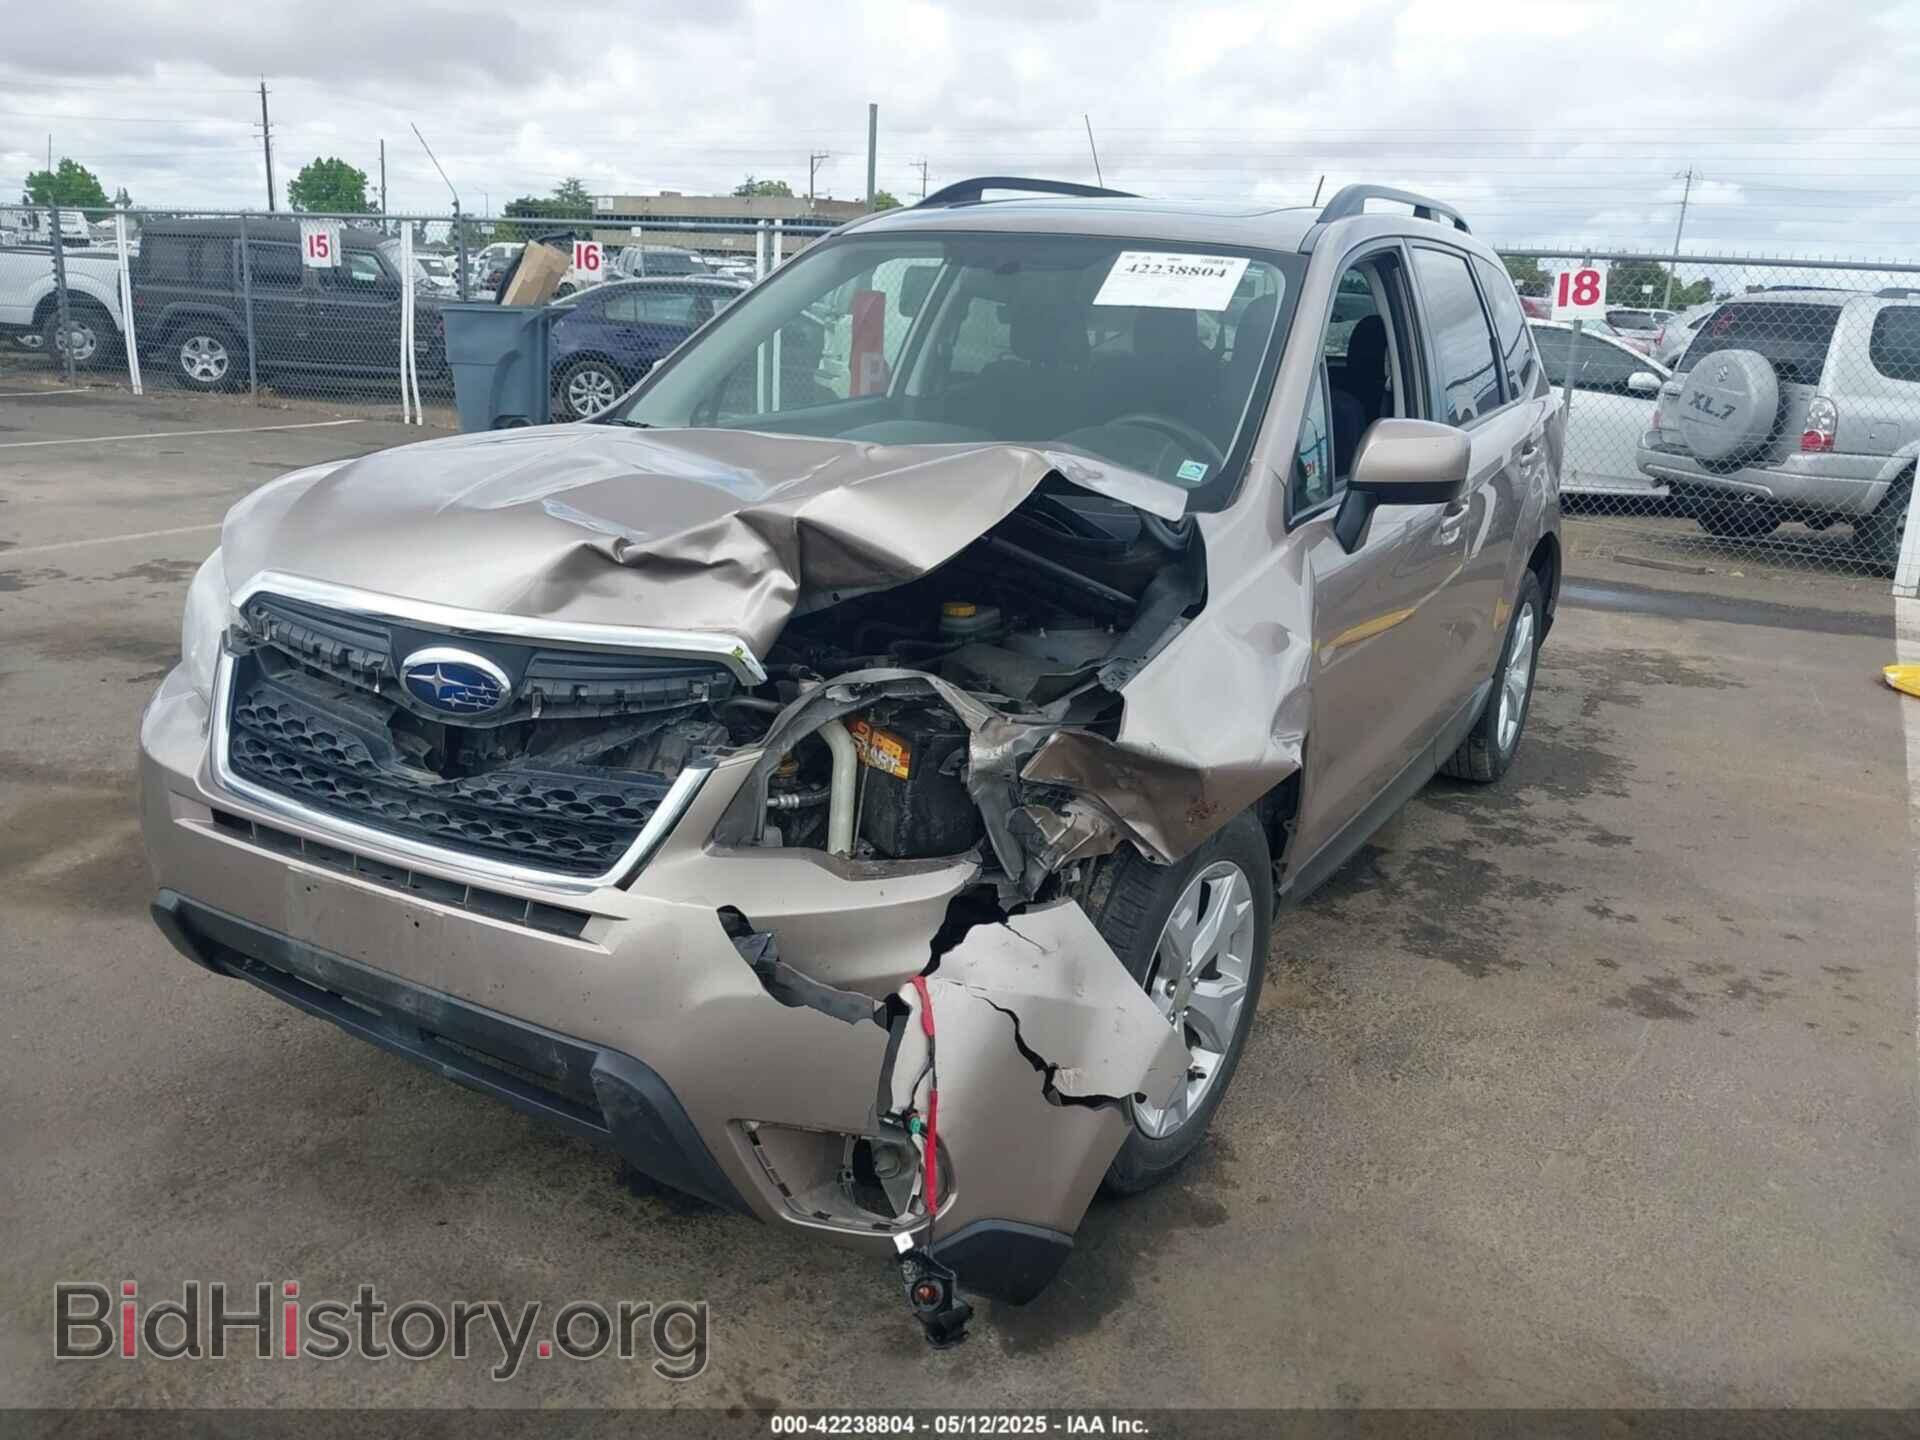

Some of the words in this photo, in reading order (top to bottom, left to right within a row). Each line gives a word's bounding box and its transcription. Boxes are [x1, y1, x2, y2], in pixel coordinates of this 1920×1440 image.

[309, 234, 328, 258] 15
[576, 243, 599, 270] 16
[1124, 263, 1227, 278] 42238804
[1558, 270, 1600, 307] 18
